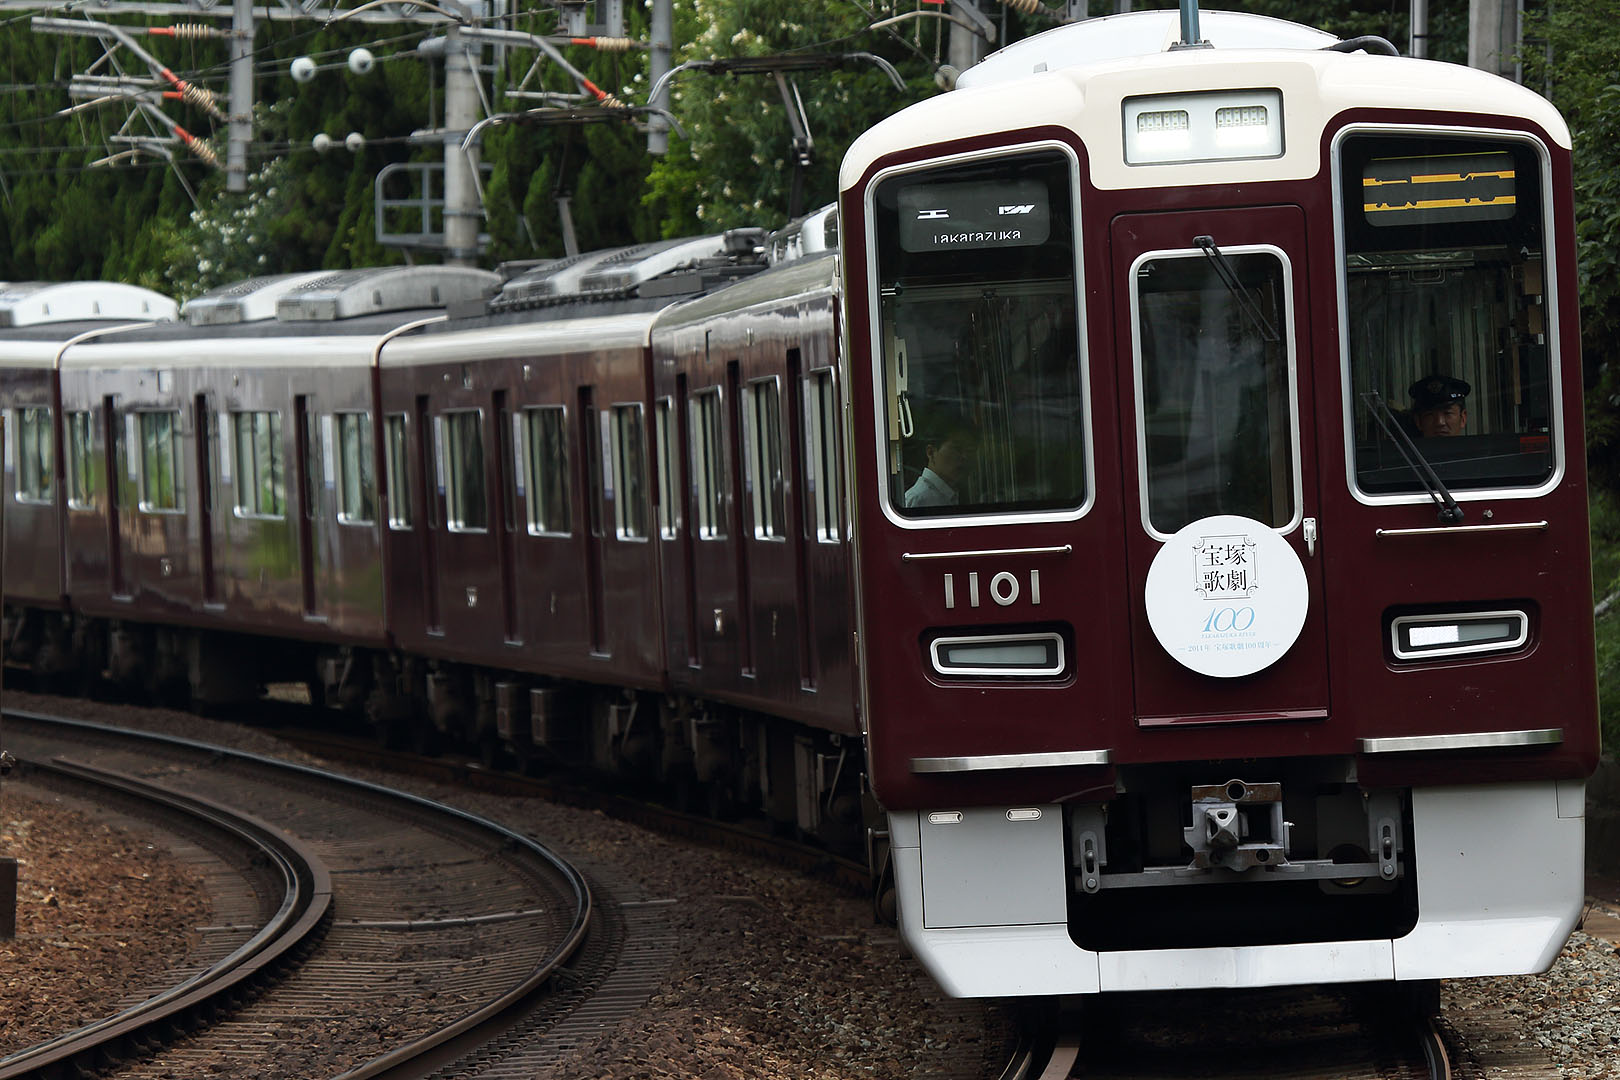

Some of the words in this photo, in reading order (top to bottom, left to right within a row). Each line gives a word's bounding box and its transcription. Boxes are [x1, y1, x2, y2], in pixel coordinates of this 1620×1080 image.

[1202, 544, 1248, 566] 宝塚
[944, 569, 1041, 609] 1101
[1203, 569, 1247, 592] 歌劇
[1202, 606, 1256, 633] 100
